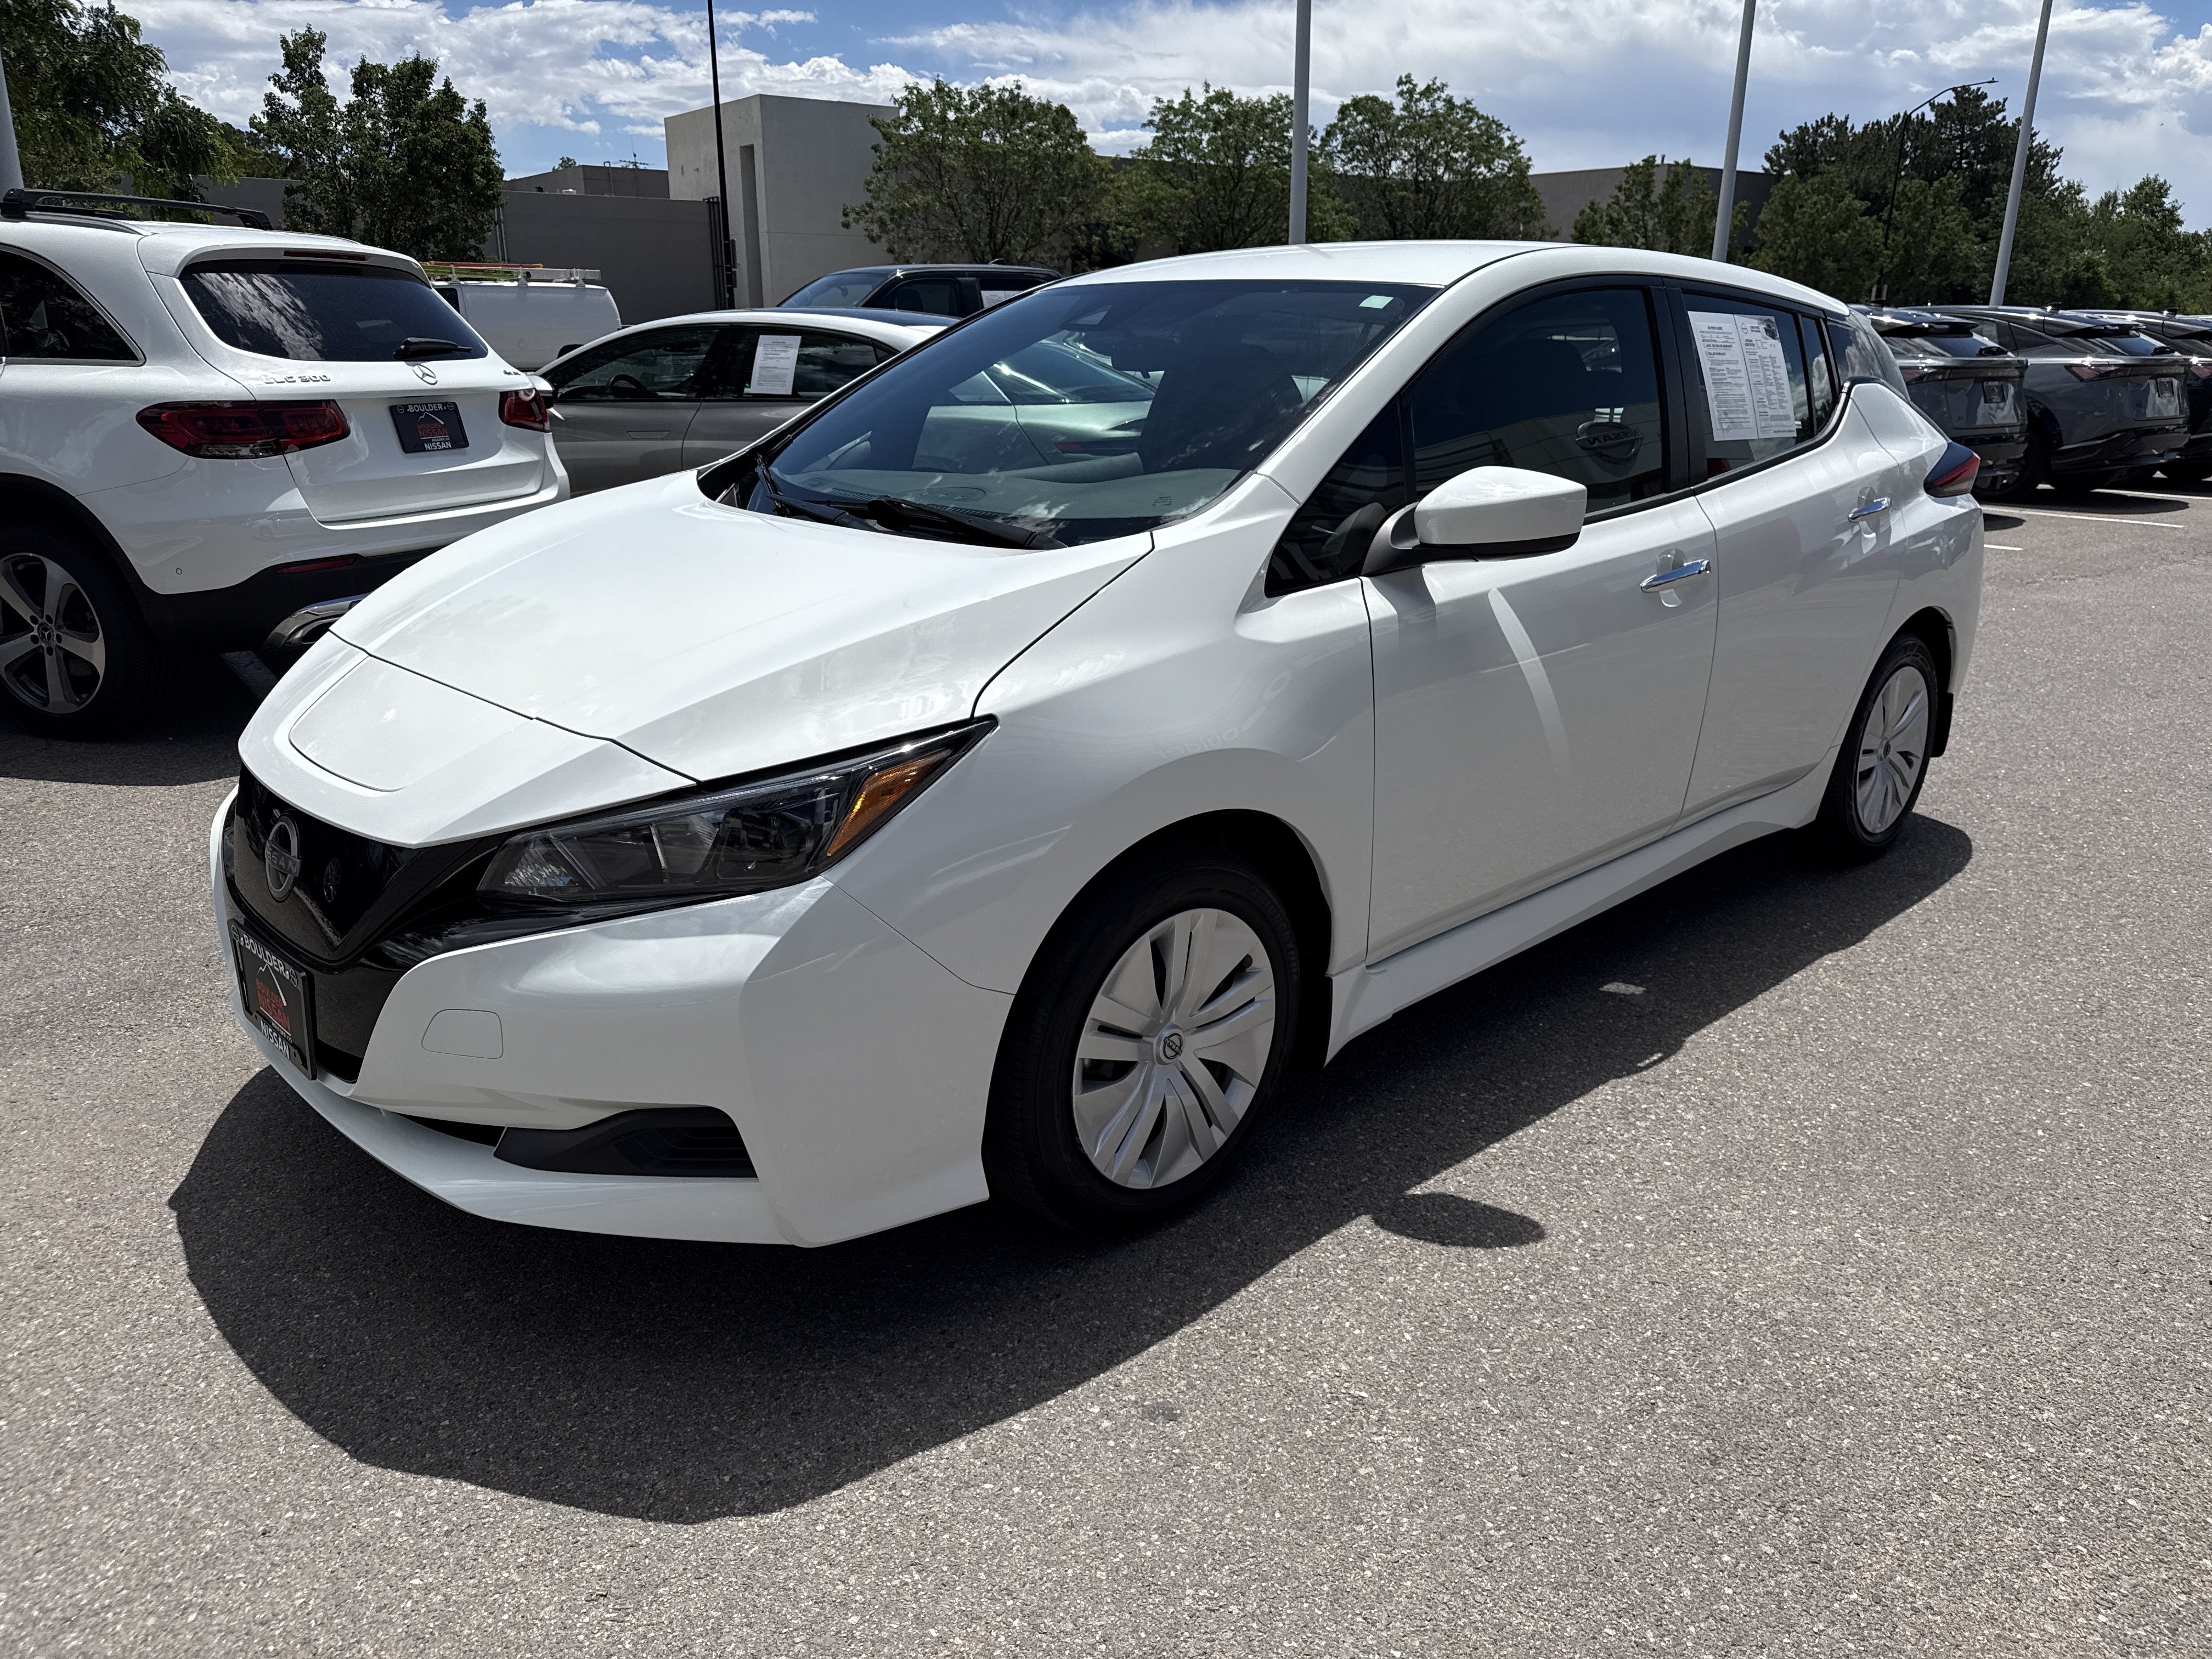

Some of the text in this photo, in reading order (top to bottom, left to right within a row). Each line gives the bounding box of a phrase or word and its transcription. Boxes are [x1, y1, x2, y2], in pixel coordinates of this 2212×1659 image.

[262, 375, 296, 384] GLC
[408, 403, 443, 412] BOULDER
[418, 427, 448, 438] NISSAN
[424, 441, 452, 450] NISSAN
[243, 933, 285, 977] BOULDER
[256, 978, 283, 1009] BOULDER
[257, 989, 290, 1032] NISSAN
[260, 1019, 290, 1059] NISSAN
